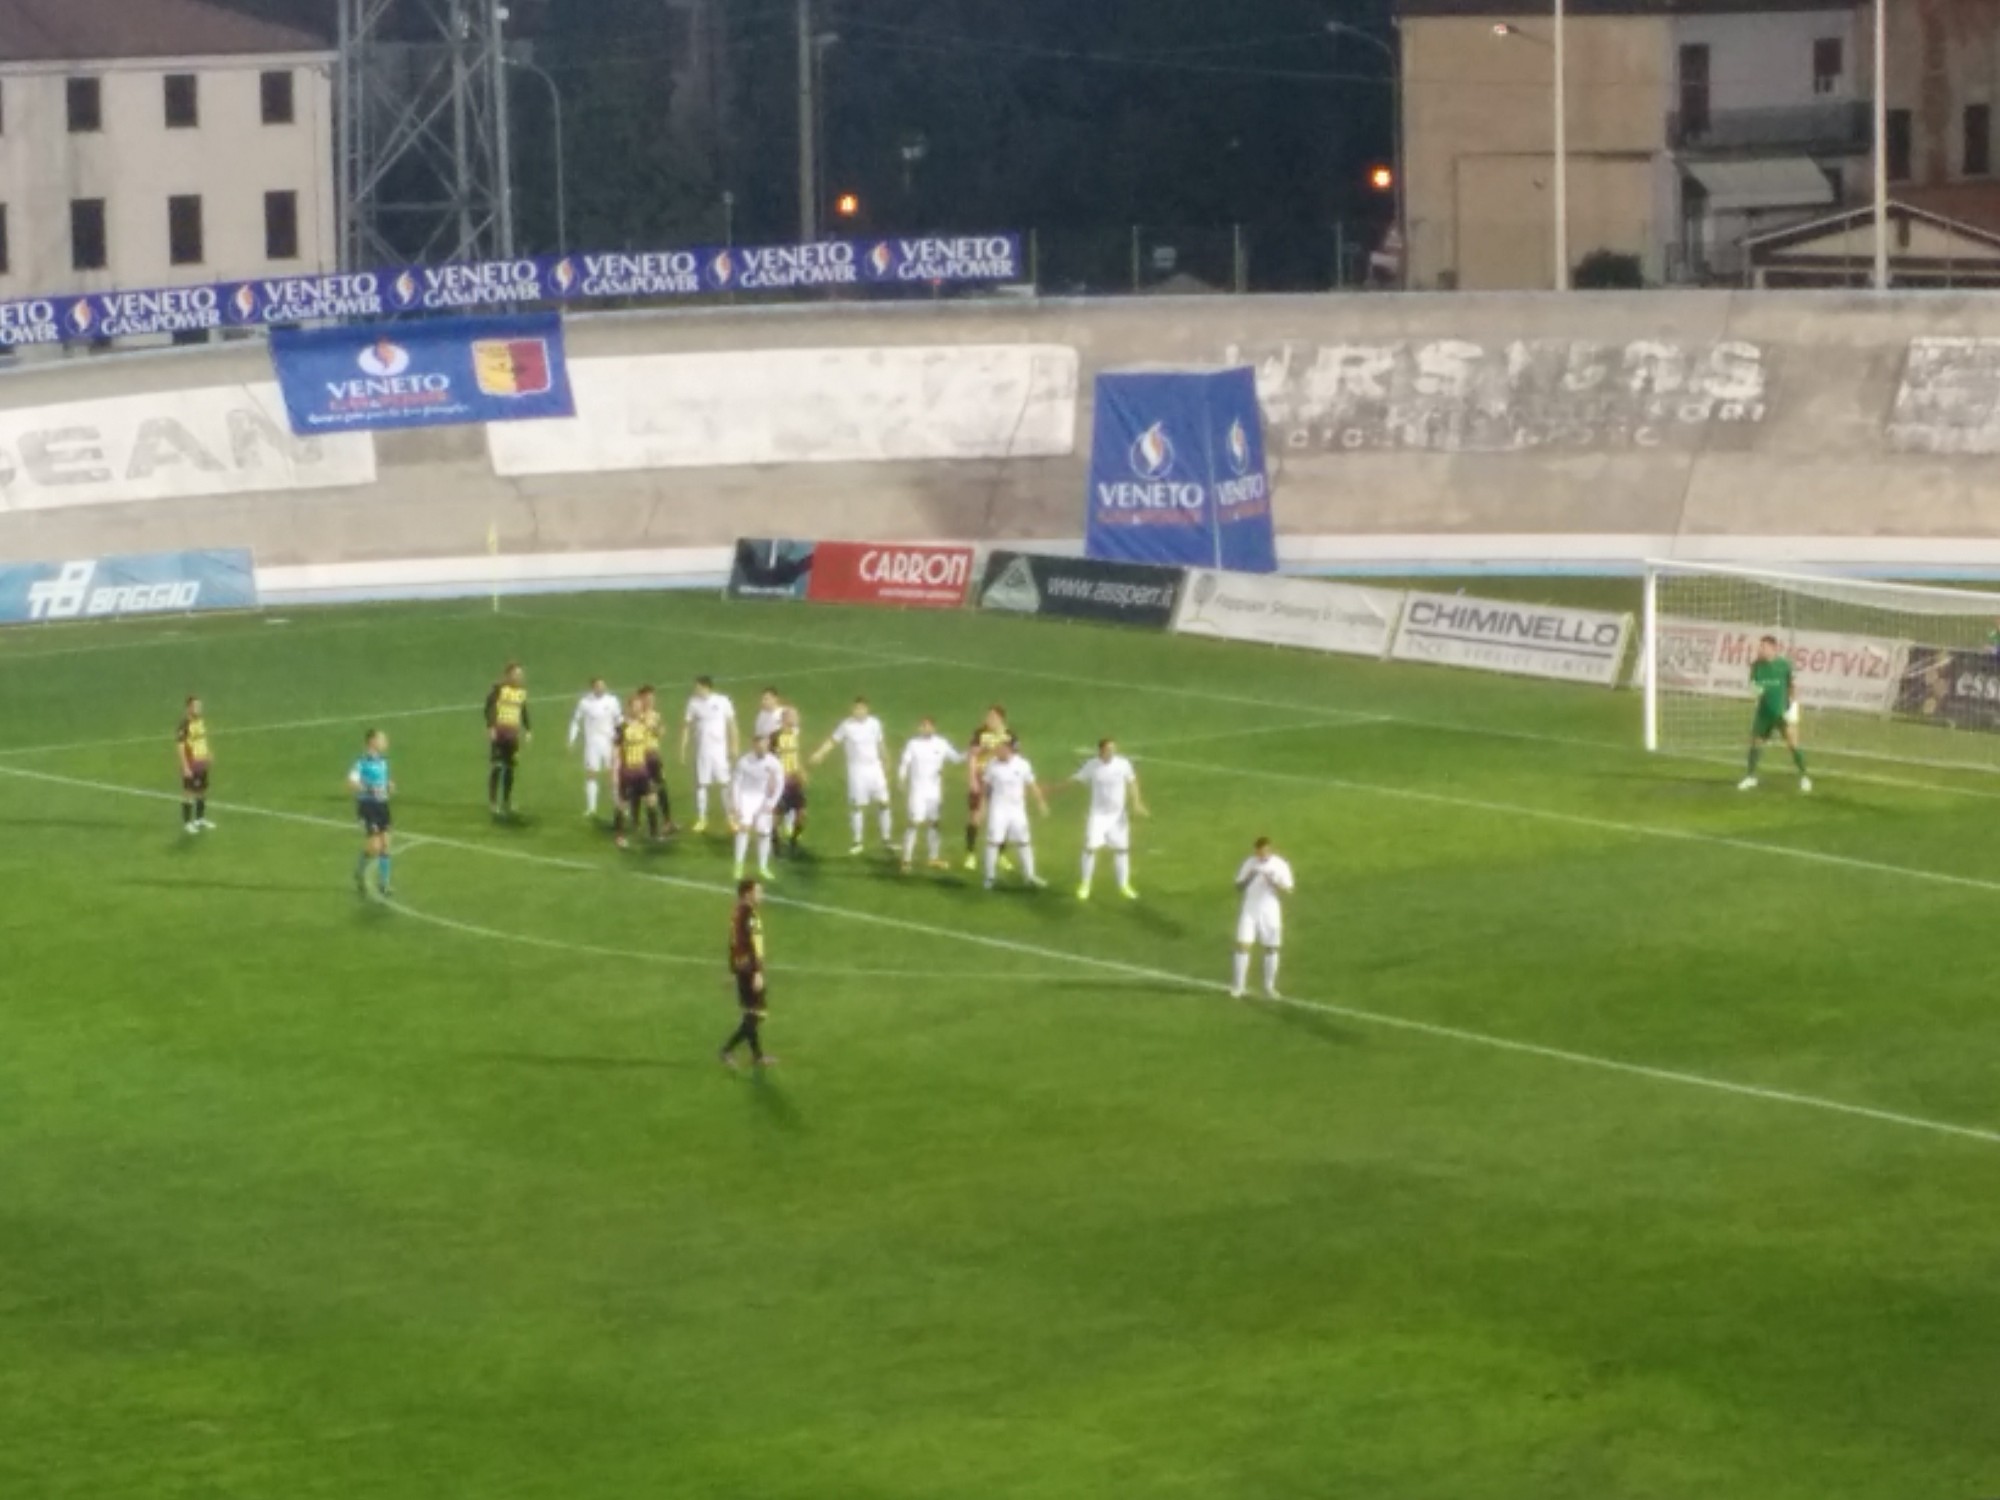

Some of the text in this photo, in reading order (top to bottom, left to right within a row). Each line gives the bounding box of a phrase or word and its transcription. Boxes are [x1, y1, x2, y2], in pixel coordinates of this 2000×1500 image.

[584, 252, 697, 278] VENETO
[742, 242, 853, 273] VENETO
[899, 237, 1011, 264] VENETO
[264, 272, 378, 302] VENETO
[424, 259, 538, 289] VENETO
[101, 287, 217, 317] VENETO
[326, 374, 450, 399] VENETO
[1098, 482, 1204, 508] VENETO
[859, 550, 968, 586] CARRON
[1408, 601, 1620, 648] CHIMINELLO
